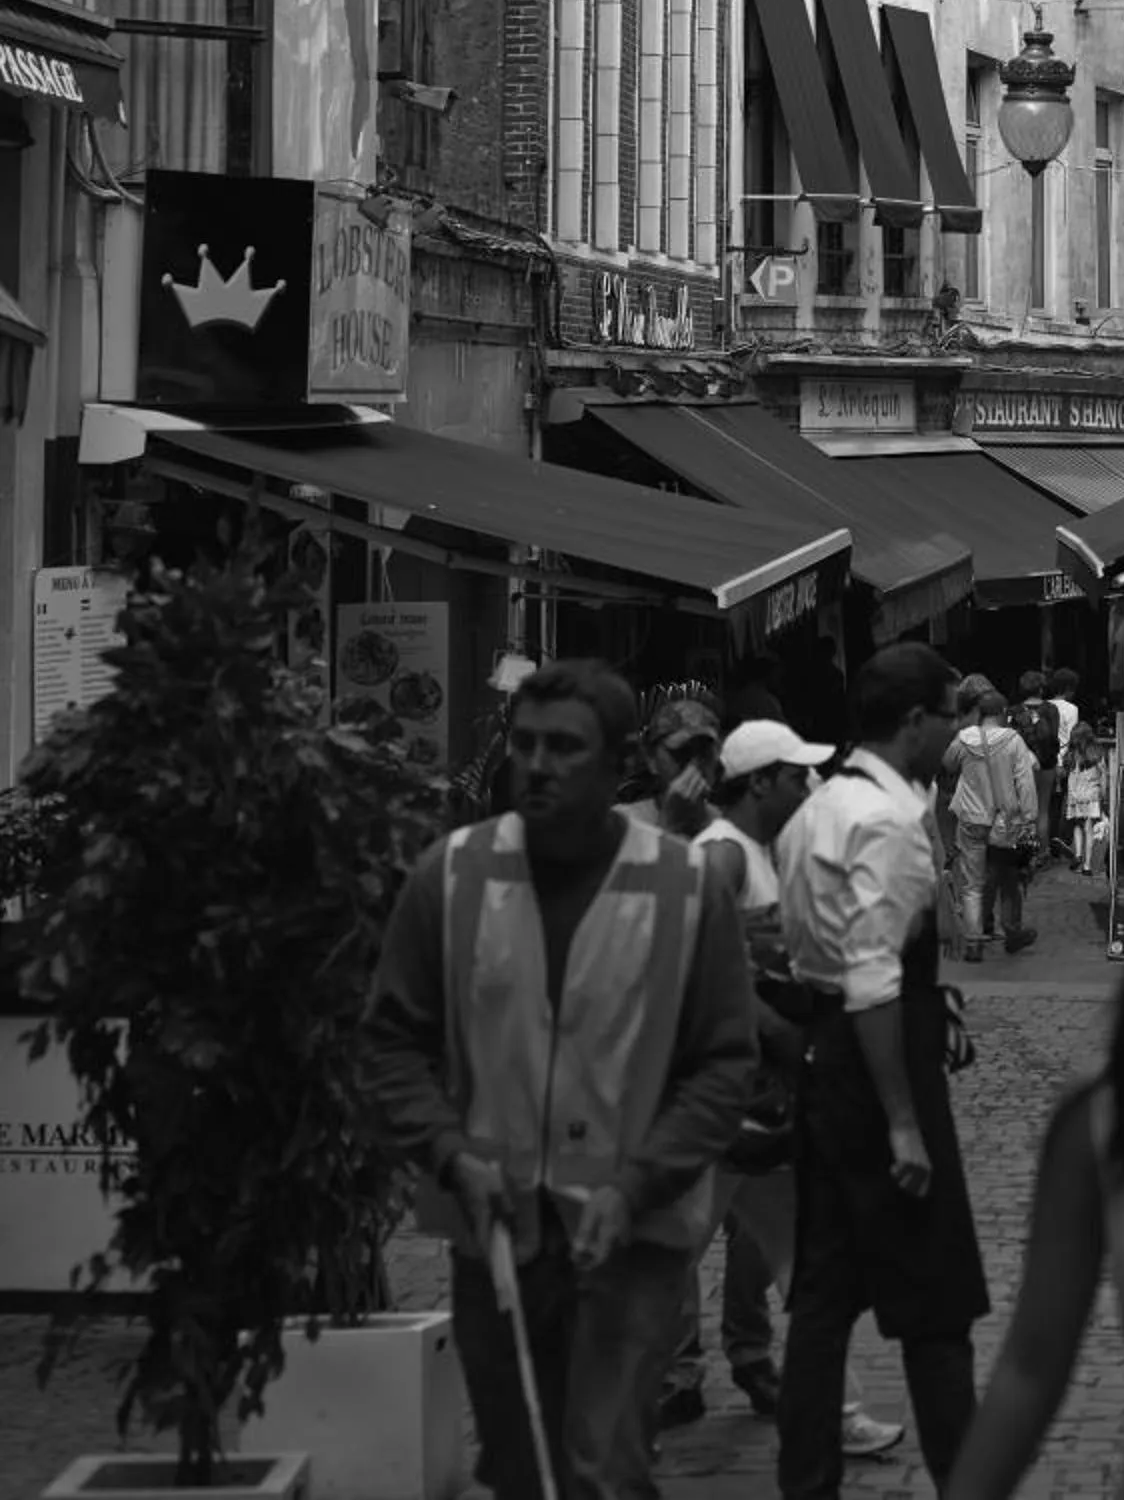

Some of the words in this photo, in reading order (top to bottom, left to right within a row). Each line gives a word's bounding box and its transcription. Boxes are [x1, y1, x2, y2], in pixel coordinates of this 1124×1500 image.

[318, 224, 406, 304] LOBSTER
[768, 265, 795, 297] P
[332, 309, 393, 371] HOUSE
